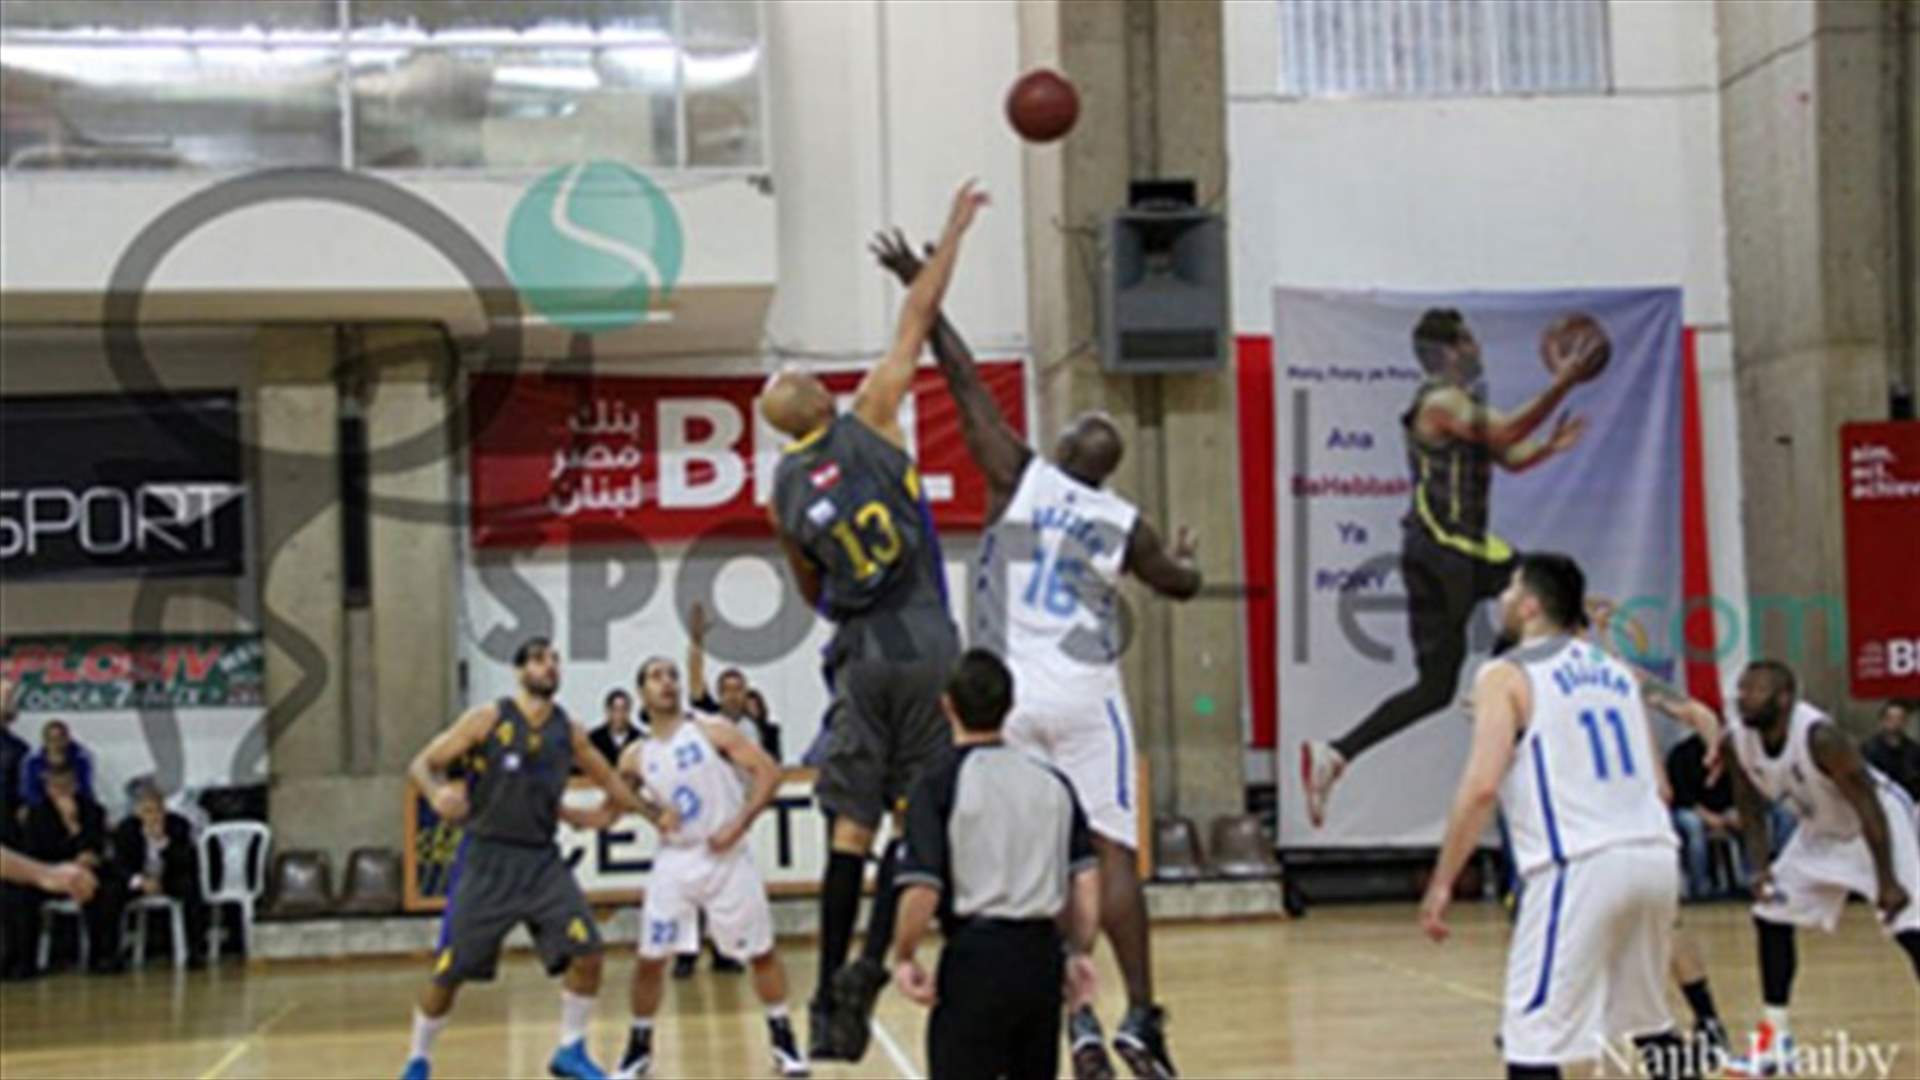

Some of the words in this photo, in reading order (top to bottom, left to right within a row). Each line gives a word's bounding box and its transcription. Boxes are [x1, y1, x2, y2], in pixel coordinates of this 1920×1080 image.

[566, 398, 640, 438] بنك
[1328, 427, 1375, 448] Ana
[549, 443, 641, 478] مصر
[548, 474, 643, 518] لبنان
[831, 501, 901, 580] 13
[1336, 521, 1368, 543] Ya
[1023, 547, 1081, 618] 16
[1579, 708, 1635, 780] 11
